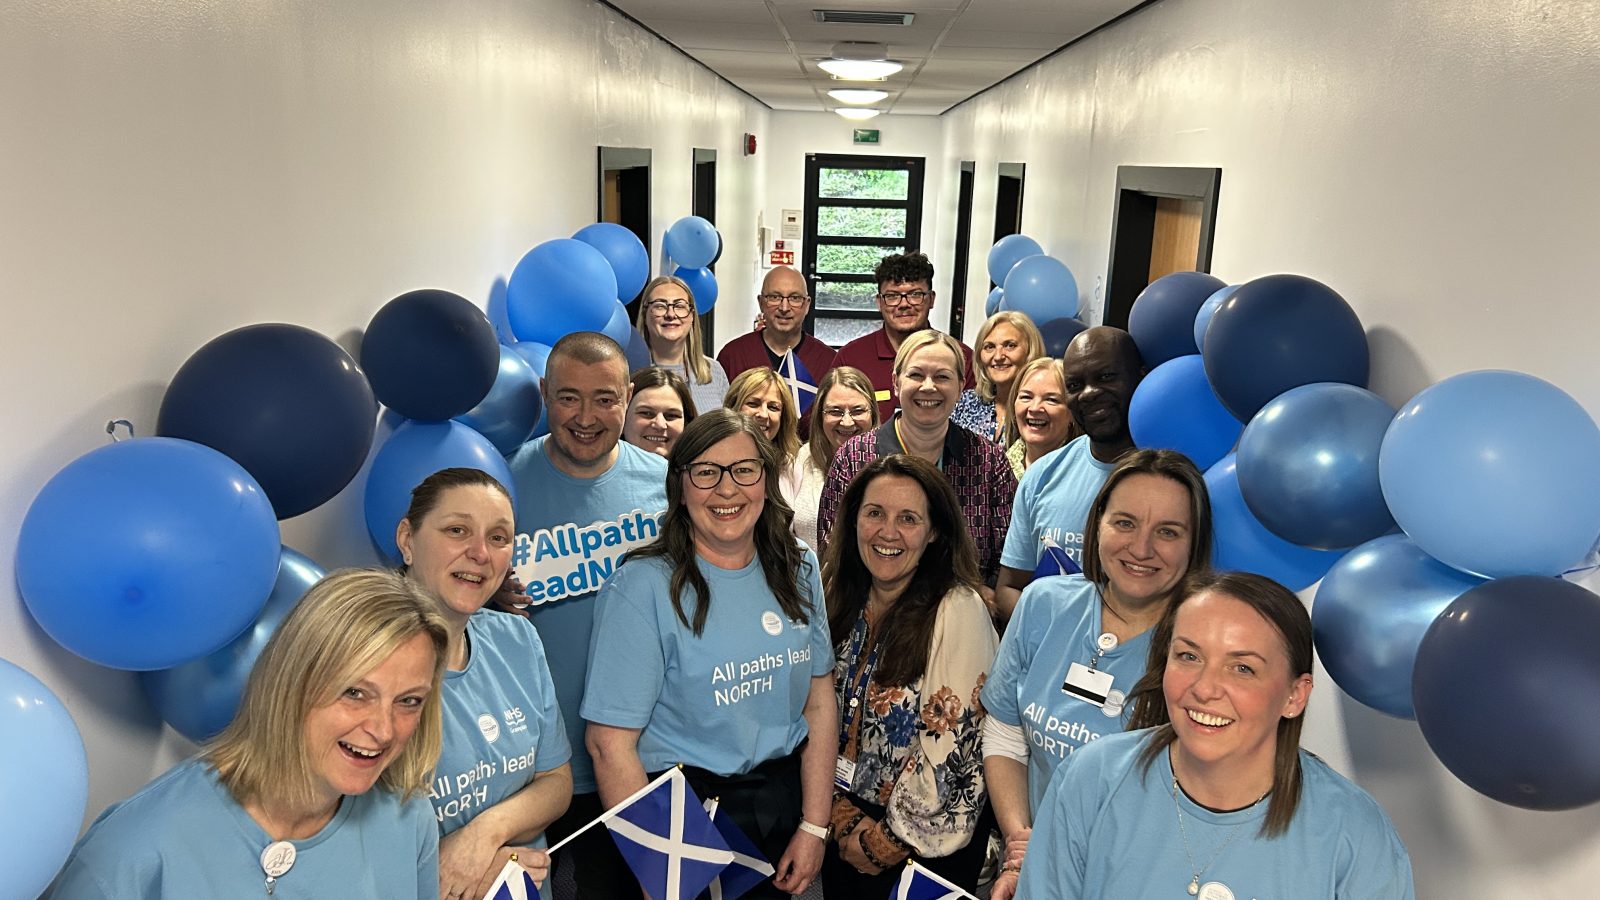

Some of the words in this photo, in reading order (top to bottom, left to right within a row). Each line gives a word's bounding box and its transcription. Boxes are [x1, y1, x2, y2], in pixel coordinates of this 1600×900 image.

[712, 661, 735, 684] All
[740, 653, 784, 680] paths
[787, 644, 811, 665] lead
[714, 675, 773, 707] NORTH
[504, 707, 523, 721] NHS
[1023, 702, 1046, 724] All
[503, 746, 535, 774] lead
